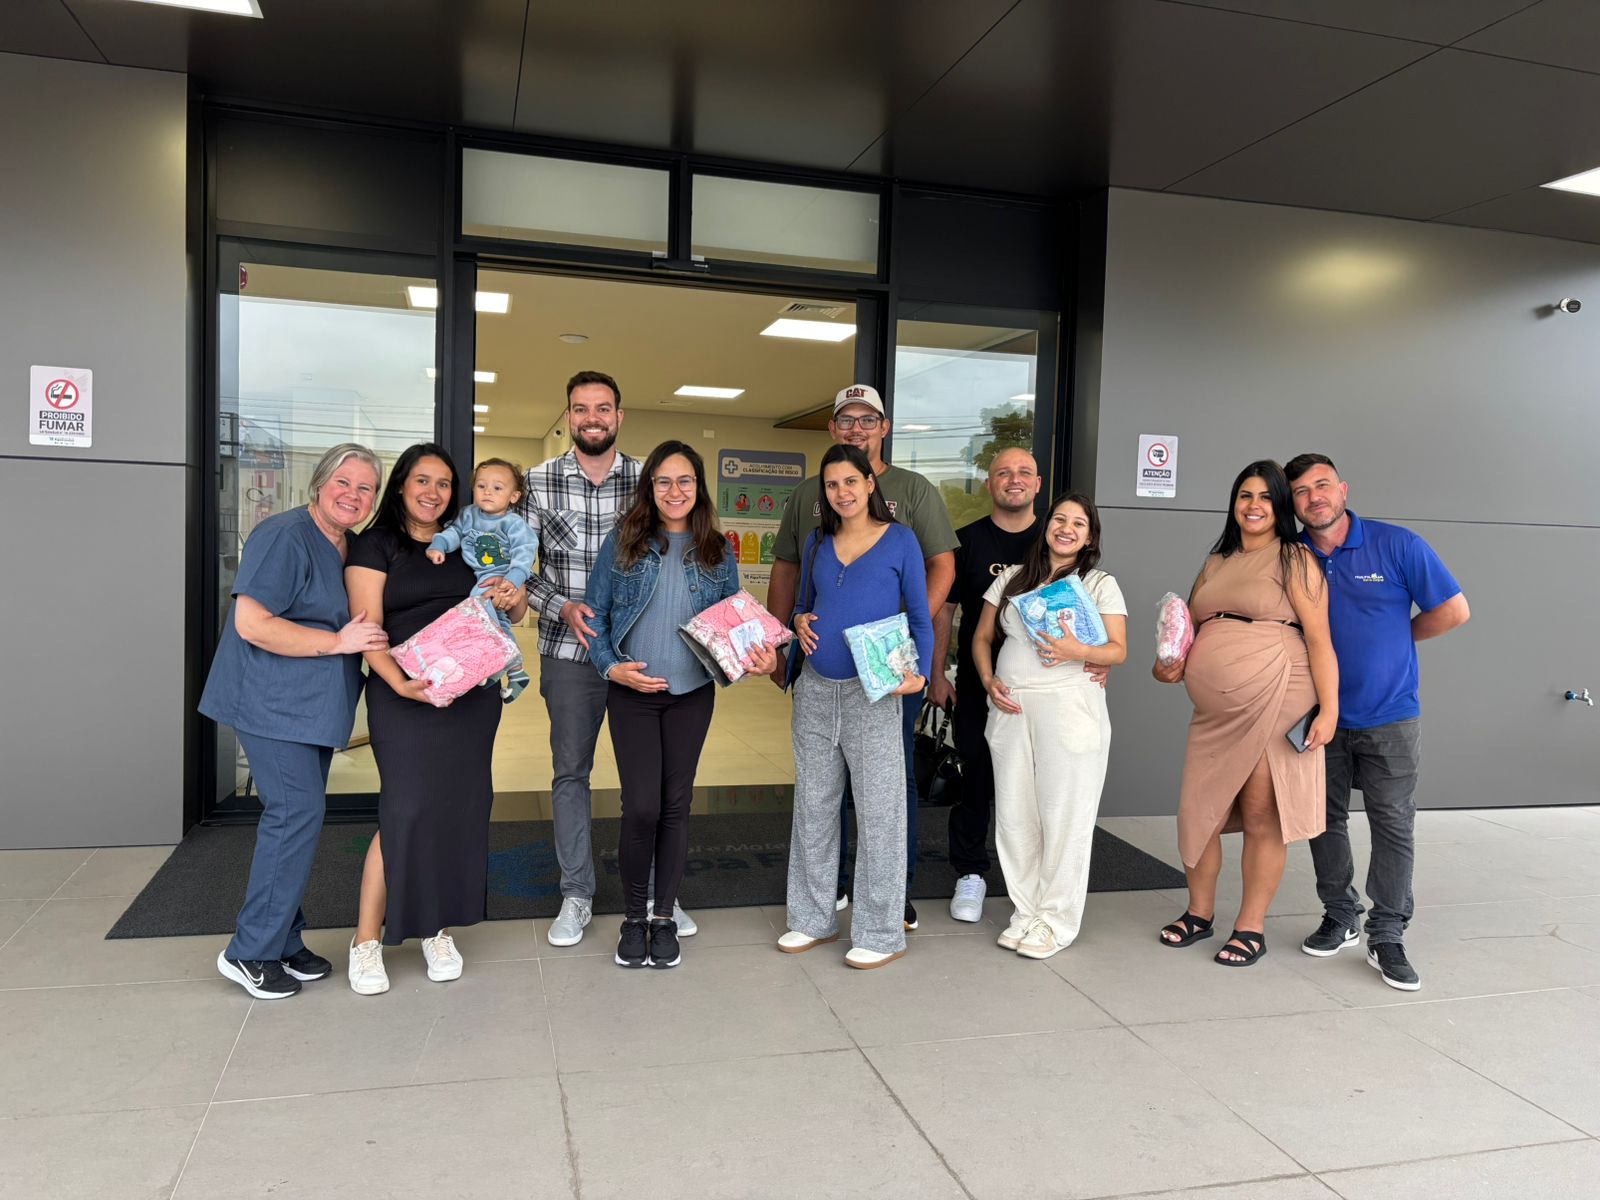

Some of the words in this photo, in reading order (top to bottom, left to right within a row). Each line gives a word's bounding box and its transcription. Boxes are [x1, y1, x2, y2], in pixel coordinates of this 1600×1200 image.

[846, 387, 866, 399] CAT
[42, 411, 82, 421] PROIBIDO
[39, 420, 84, 432] FUMAR
[1144, 469, 1170, 478] ATENÇÃO
